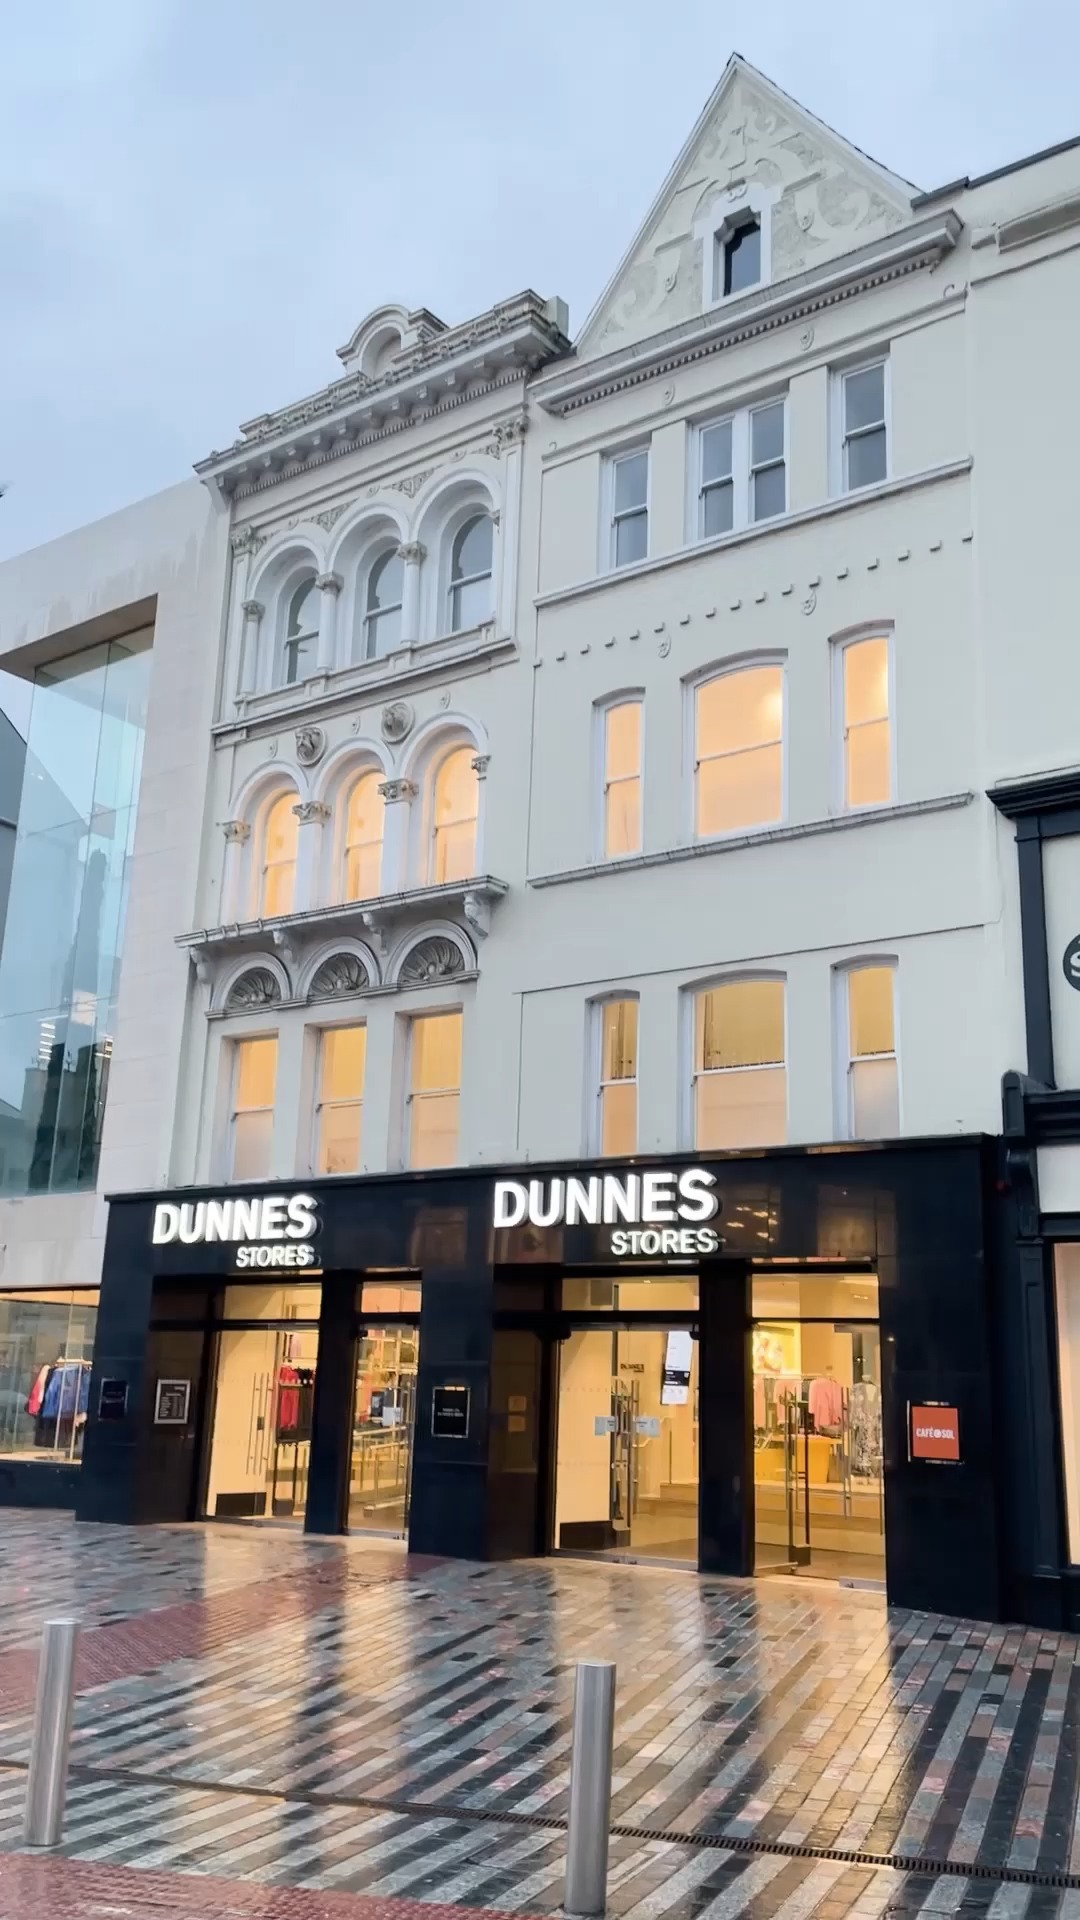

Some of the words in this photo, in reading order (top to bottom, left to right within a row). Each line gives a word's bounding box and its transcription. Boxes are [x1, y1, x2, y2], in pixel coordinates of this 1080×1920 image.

[493, 1169, 718, 1229] DUNNES
[152, 1194, 318, 1244] DUNNES
[236, 1244, 315, 1268] STORES
[611, 1228, 718, 1256] STORES
